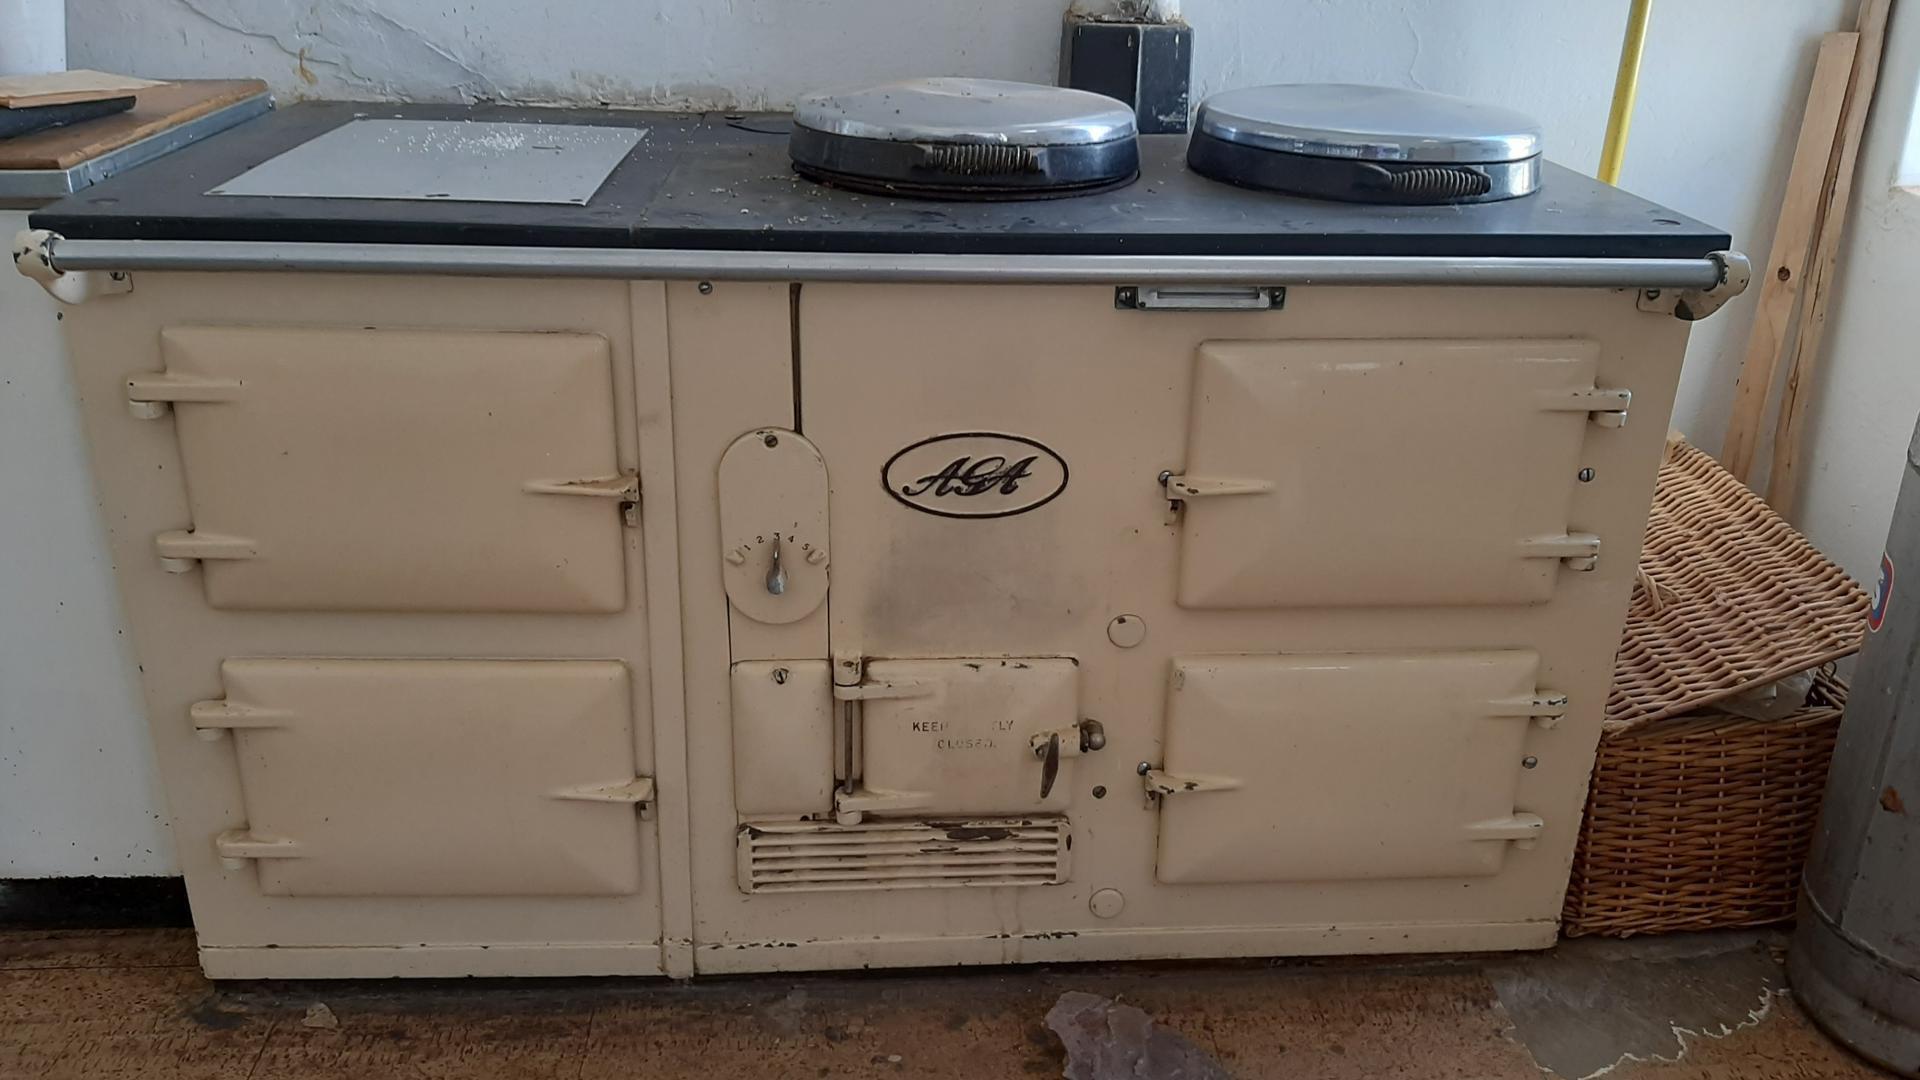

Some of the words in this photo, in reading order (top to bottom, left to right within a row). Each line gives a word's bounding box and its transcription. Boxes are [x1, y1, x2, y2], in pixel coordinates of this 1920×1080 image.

[902, 456, 1038, 496] AGA
[756, 535, 764, 544] 2
[773, 532, 780, 541] 3
[787, 535, 794, 543] 4
[802, 543, 810, 551] 5
